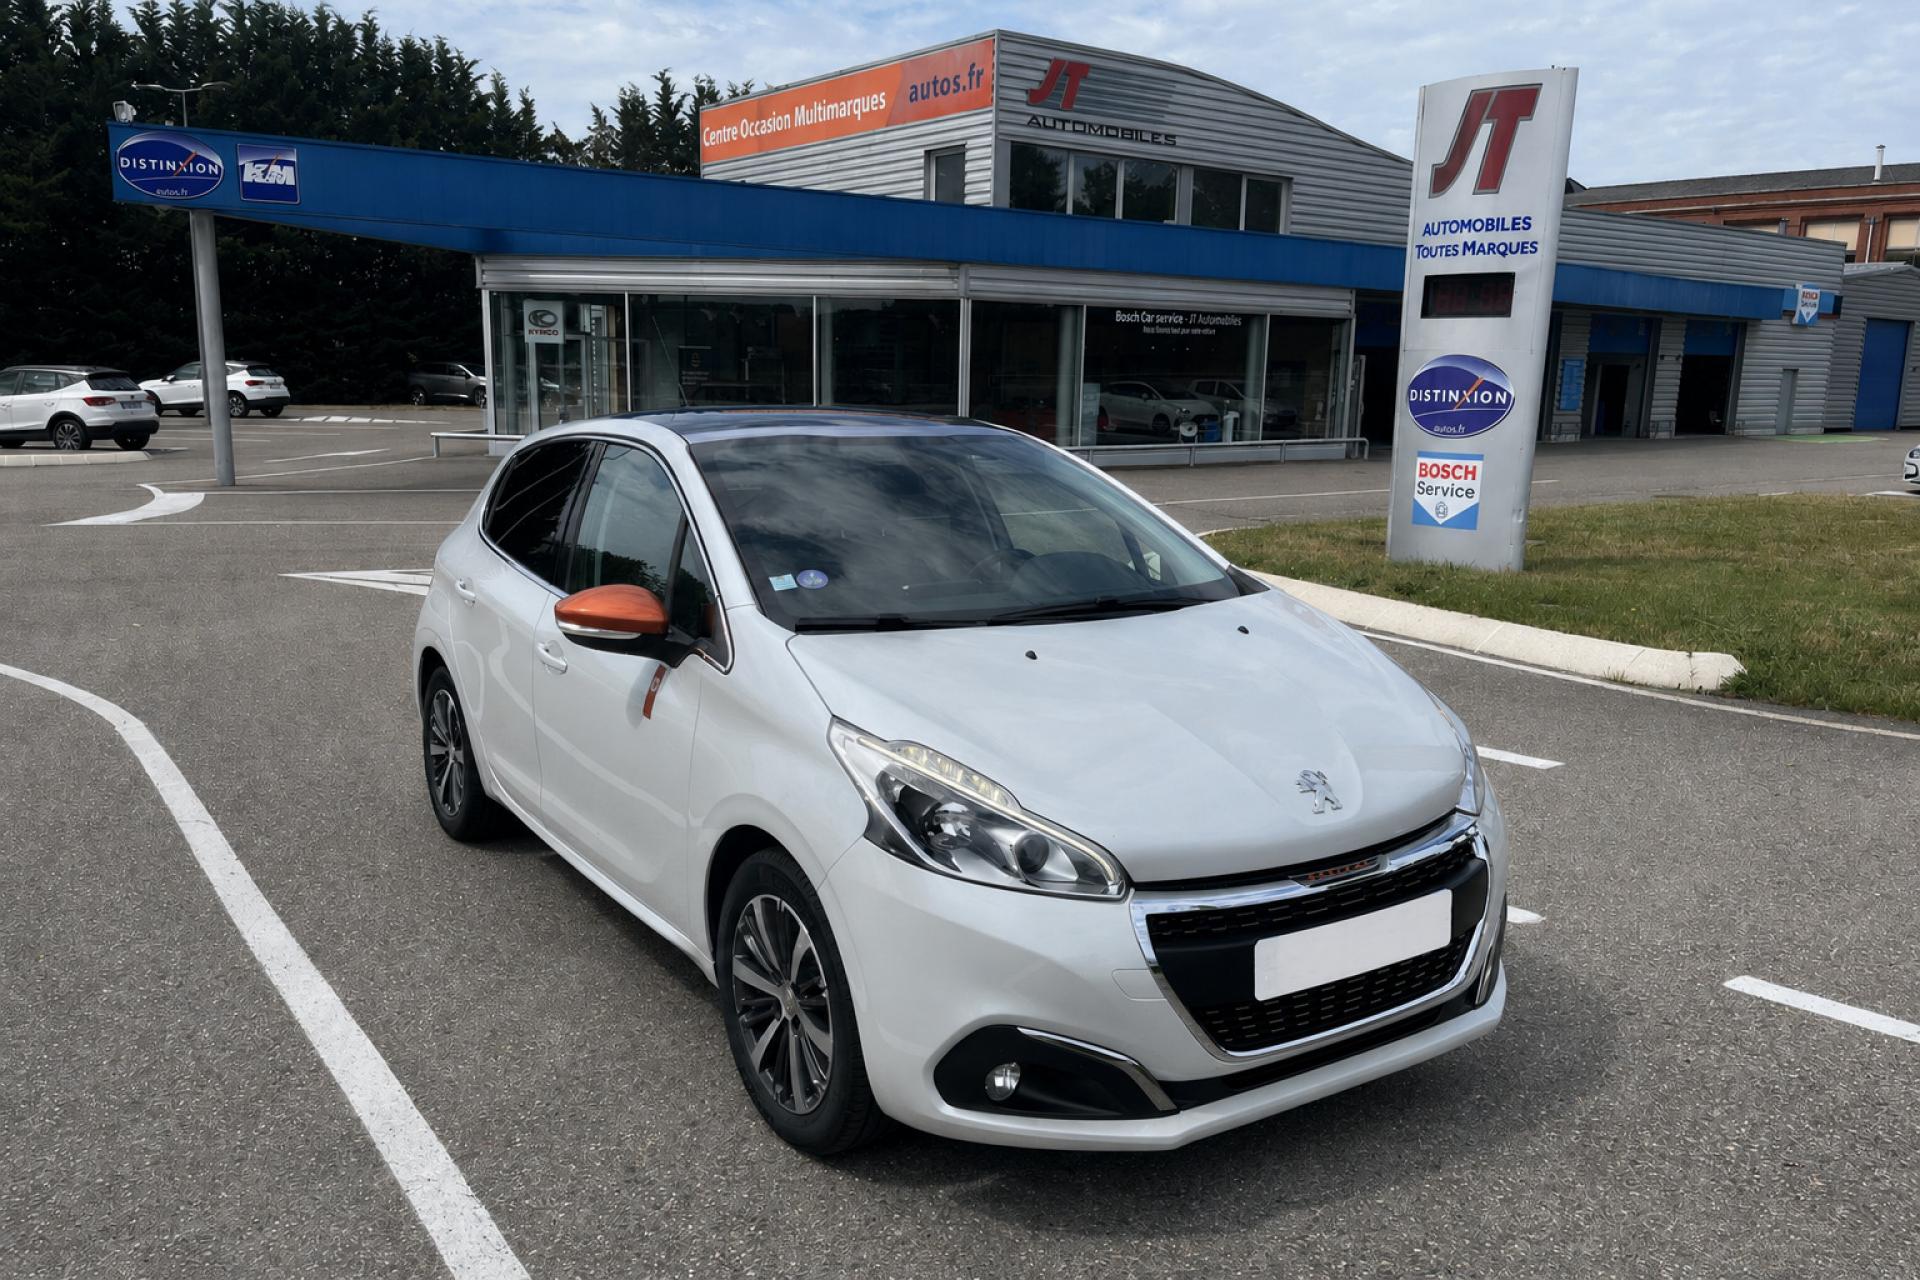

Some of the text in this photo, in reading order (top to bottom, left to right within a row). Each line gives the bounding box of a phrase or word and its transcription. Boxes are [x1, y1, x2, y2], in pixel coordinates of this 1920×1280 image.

[909, 62, 985, 103] autos.fr
[1027, 57, 1091, 110] JT
[703, 91, 886, 147] Centre Occasion Multimarques
[1026, 114, 1177, 146] AUTOMOBILES
[1428, 83, 1543, 199] JT
[120, 156, 219, 176] DISTINXION
[1422, 215, 1532, 237] AUTOMOBILES
[1415, 240, 1539, 259] TOUTES MARQUES
[1115, 310, 1140, 322] Bosch
[1141, 311, 1153, 323] Car
[1155, 312, 1184, 324] service
[1409, 388, 1507, 405] DISTINXION
[1417, 462, 1477, 481] BOSCH
[1416, 481, 1475, 499] Service
